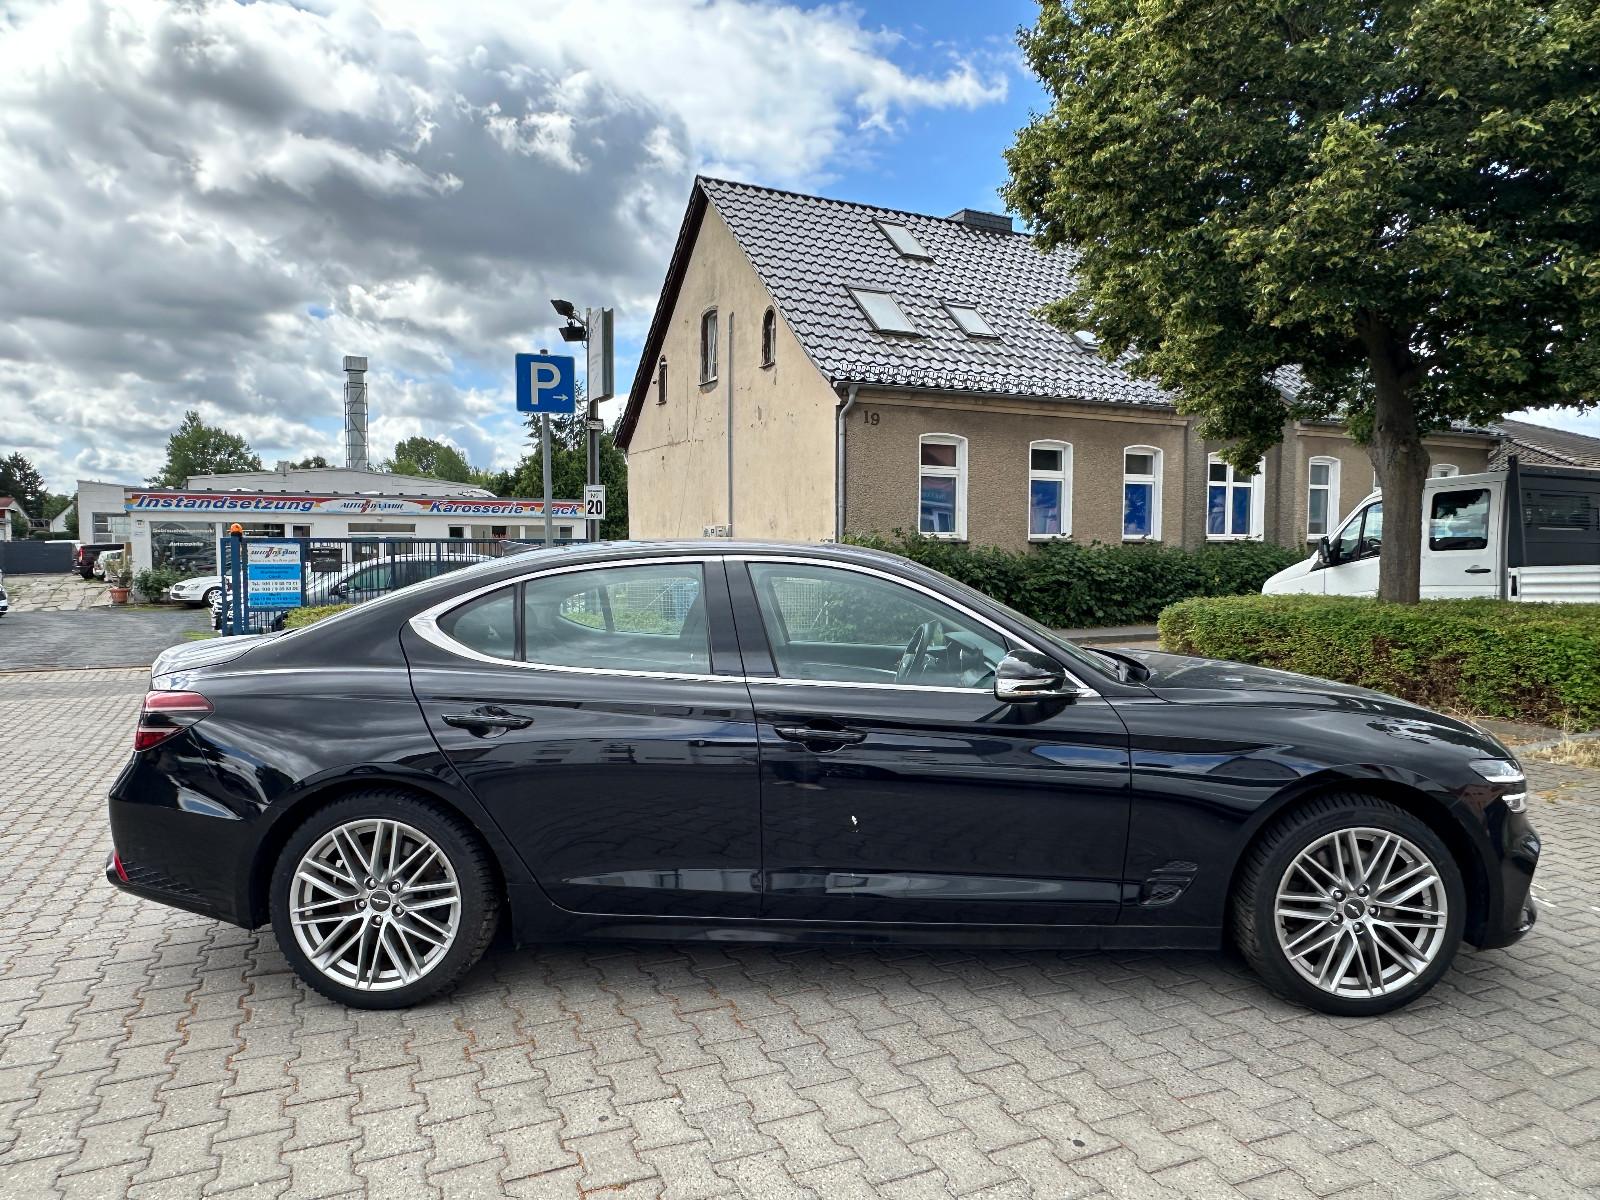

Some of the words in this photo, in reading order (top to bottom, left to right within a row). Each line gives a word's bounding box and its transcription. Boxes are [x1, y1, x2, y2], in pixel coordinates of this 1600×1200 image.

[530, 361, 561, 405] P
[863, 410, 880, 426] 19
[137, 495, 315, 512] Instandsetzung
[429, 501, 523, 514] Karosserie
[541, 503, 579, 515] ack
[587, 499, 603, 515] 20
